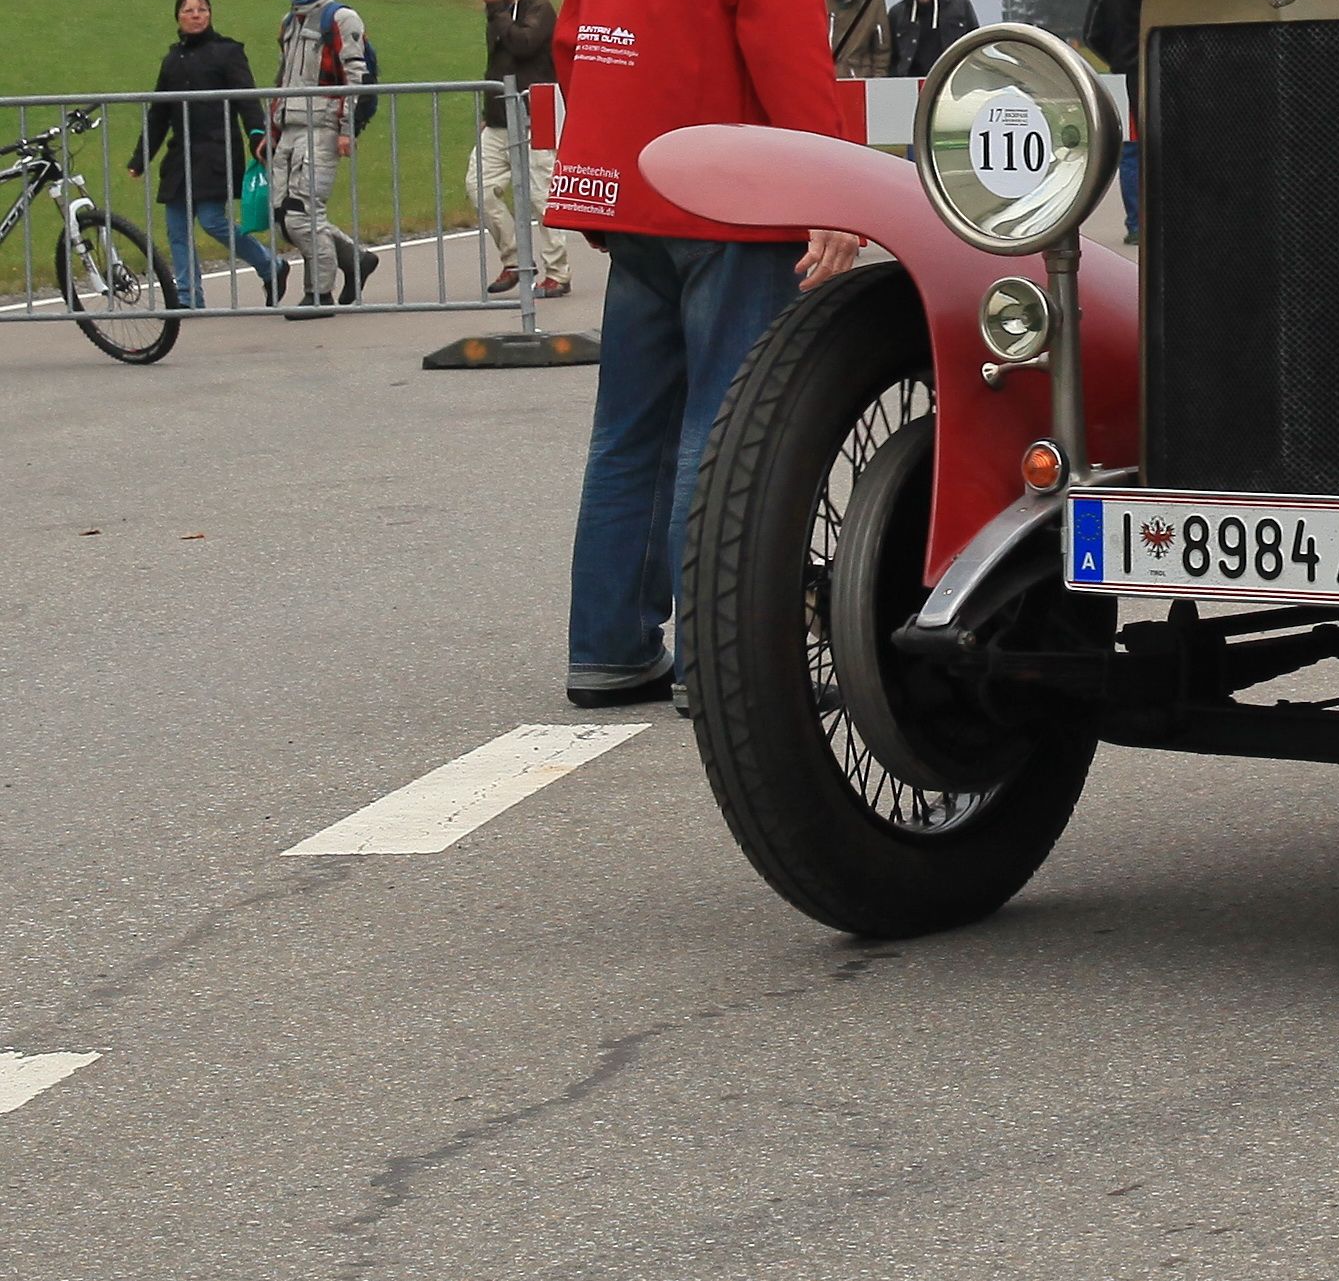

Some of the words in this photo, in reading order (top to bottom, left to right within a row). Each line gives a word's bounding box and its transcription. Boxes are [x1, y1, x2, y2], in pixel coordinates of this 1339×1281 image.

[601, 35, 636, 46] OUTLET
[978, 130, 1045, 172] 110
[562, 164, 620, 179] werbetechnik
[550, 175, 619, 204] spreng
[1182, 514, 1321, 583] 8984
[1080, 552, 1096, 571] A
